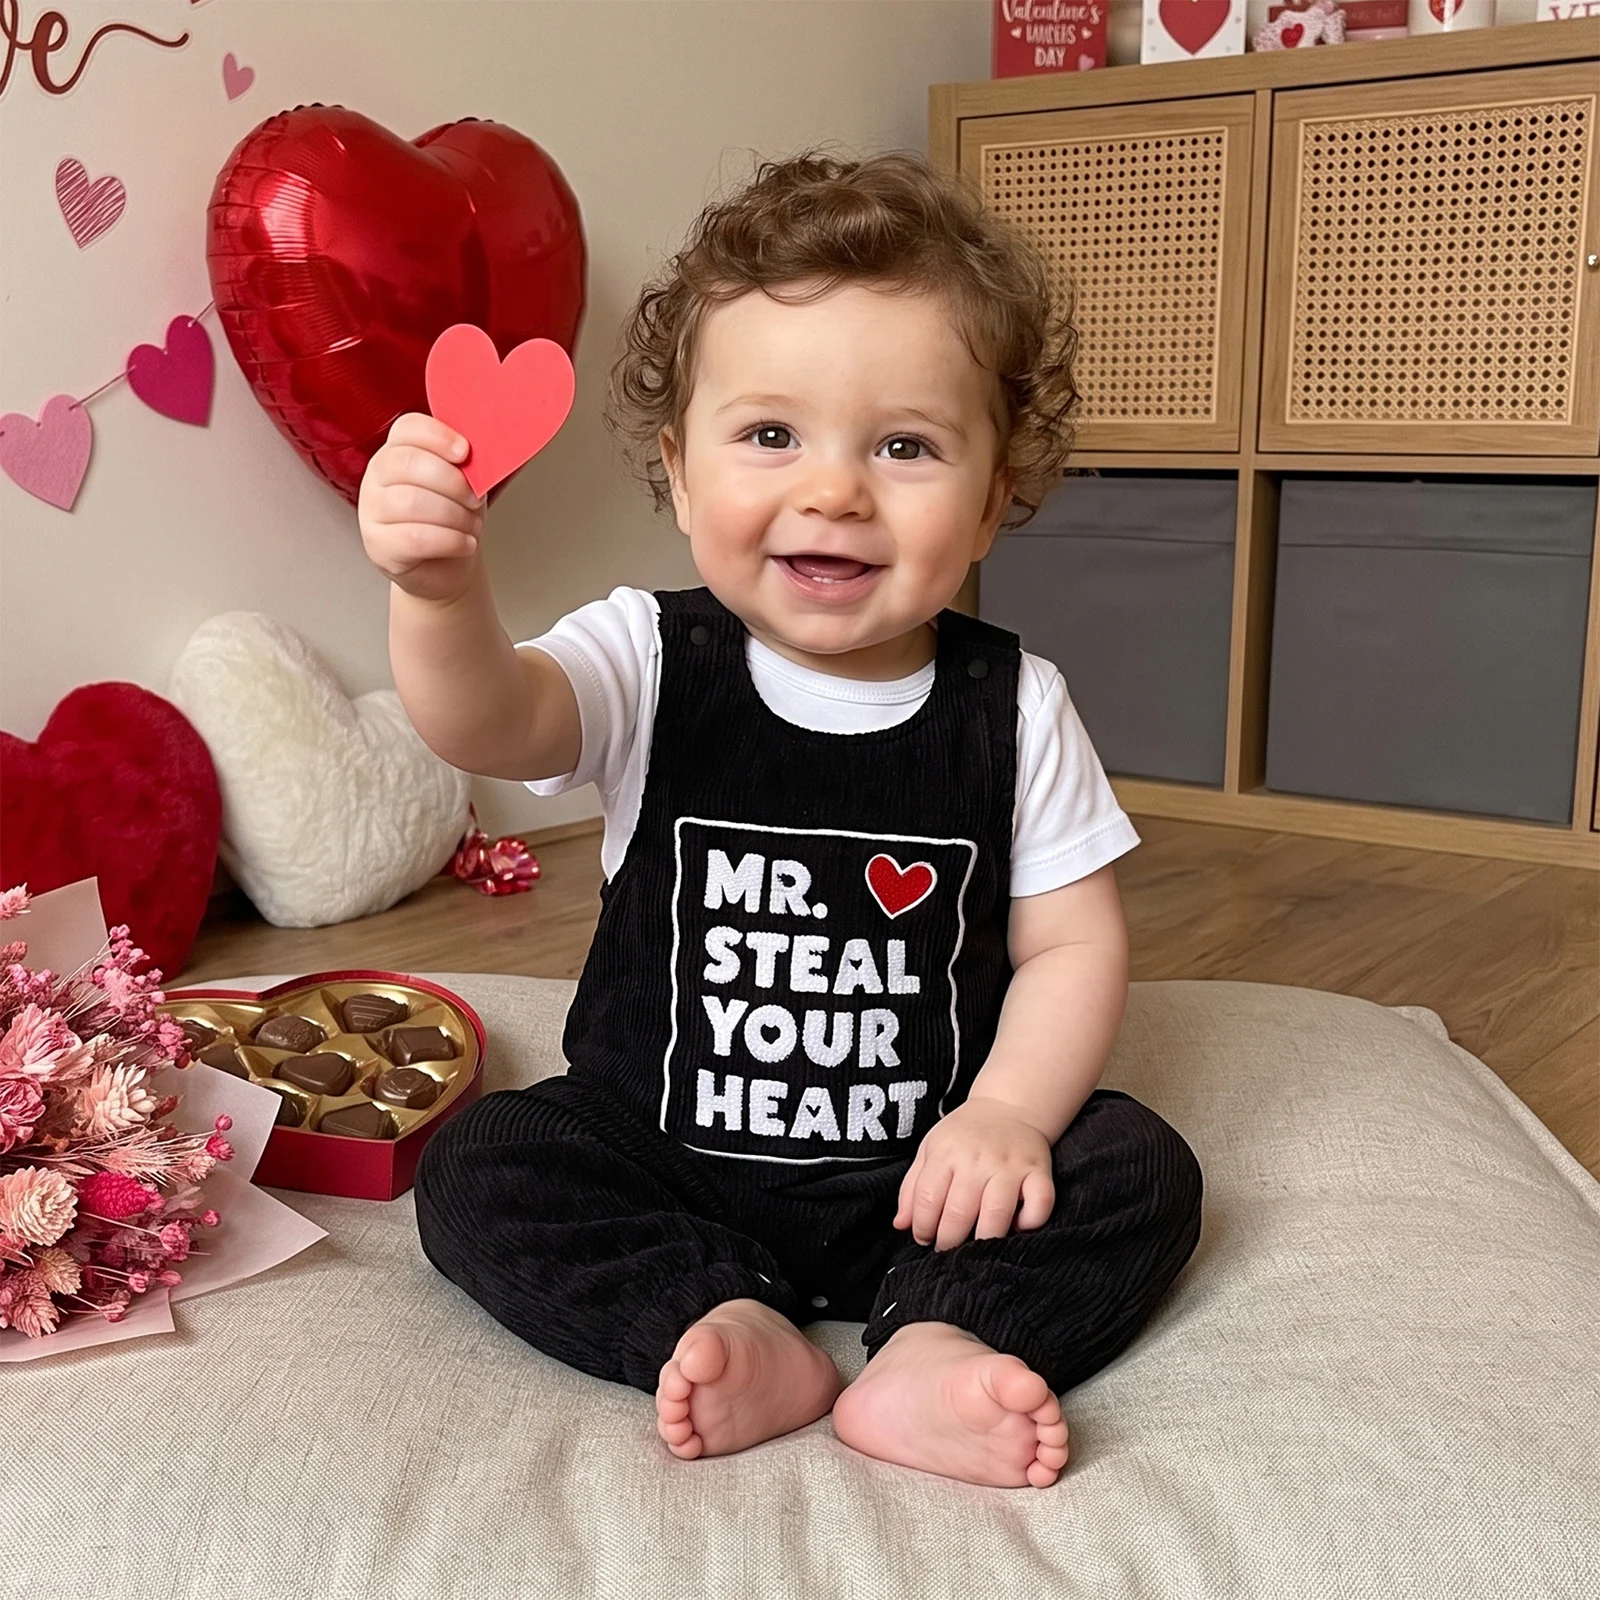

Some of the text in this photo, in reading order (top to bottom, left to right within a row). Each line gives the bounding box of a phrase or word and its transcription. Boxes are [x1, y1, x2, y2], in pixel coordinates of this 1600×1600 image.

[1034, 46, 1066, 67] DAY
[703, 849, 828, 920] MR.
[703, 926, 921, 995] STEAL
[701, 995, 901, 1068] YOUR
[695, 1069, 928, 1141] HEART
